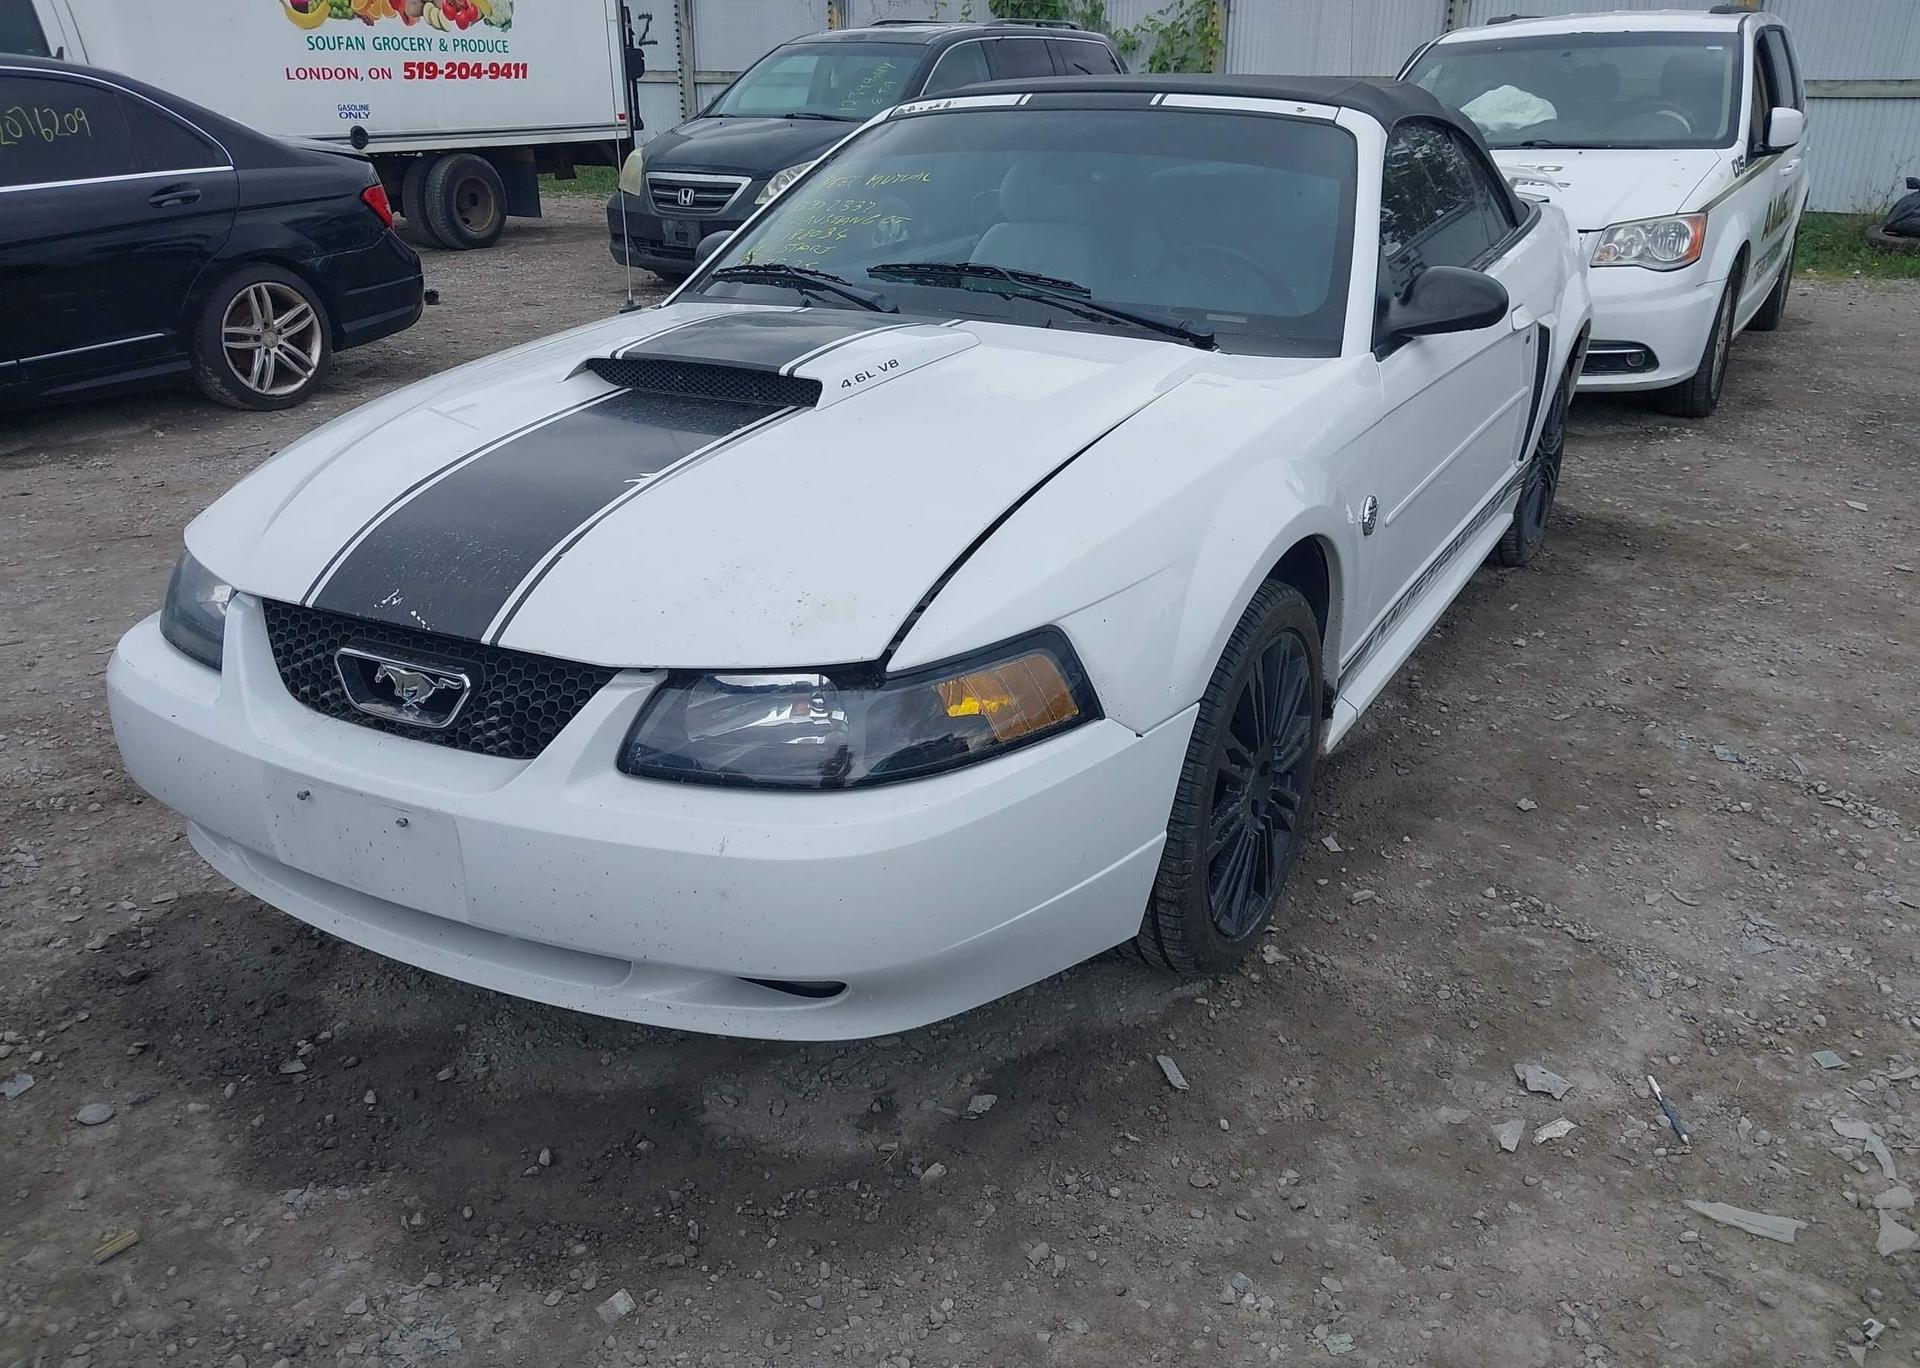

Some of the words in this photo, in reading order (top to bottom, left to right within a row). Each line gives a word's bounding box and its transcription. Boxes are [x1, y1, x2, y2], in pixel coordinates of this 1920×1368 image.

[306, 35, 366, 51] SOUFAN
[372, 36, 434, 52] GROCERY
[438, 38, 449, 52] &
[452, 38, 510, 54] PRODUCE
[285, 66, 364, 82] LONDON,
[368, 67, 393, 80] ON
[403, 61, 529, 80] 519-204-9411
[337, 103, 370, 111] GASOLINE
[339, 111, 371, 120] ONLY
[841, 370, 876, 389] 4.6L
[877, 358, 899, 373] V8
